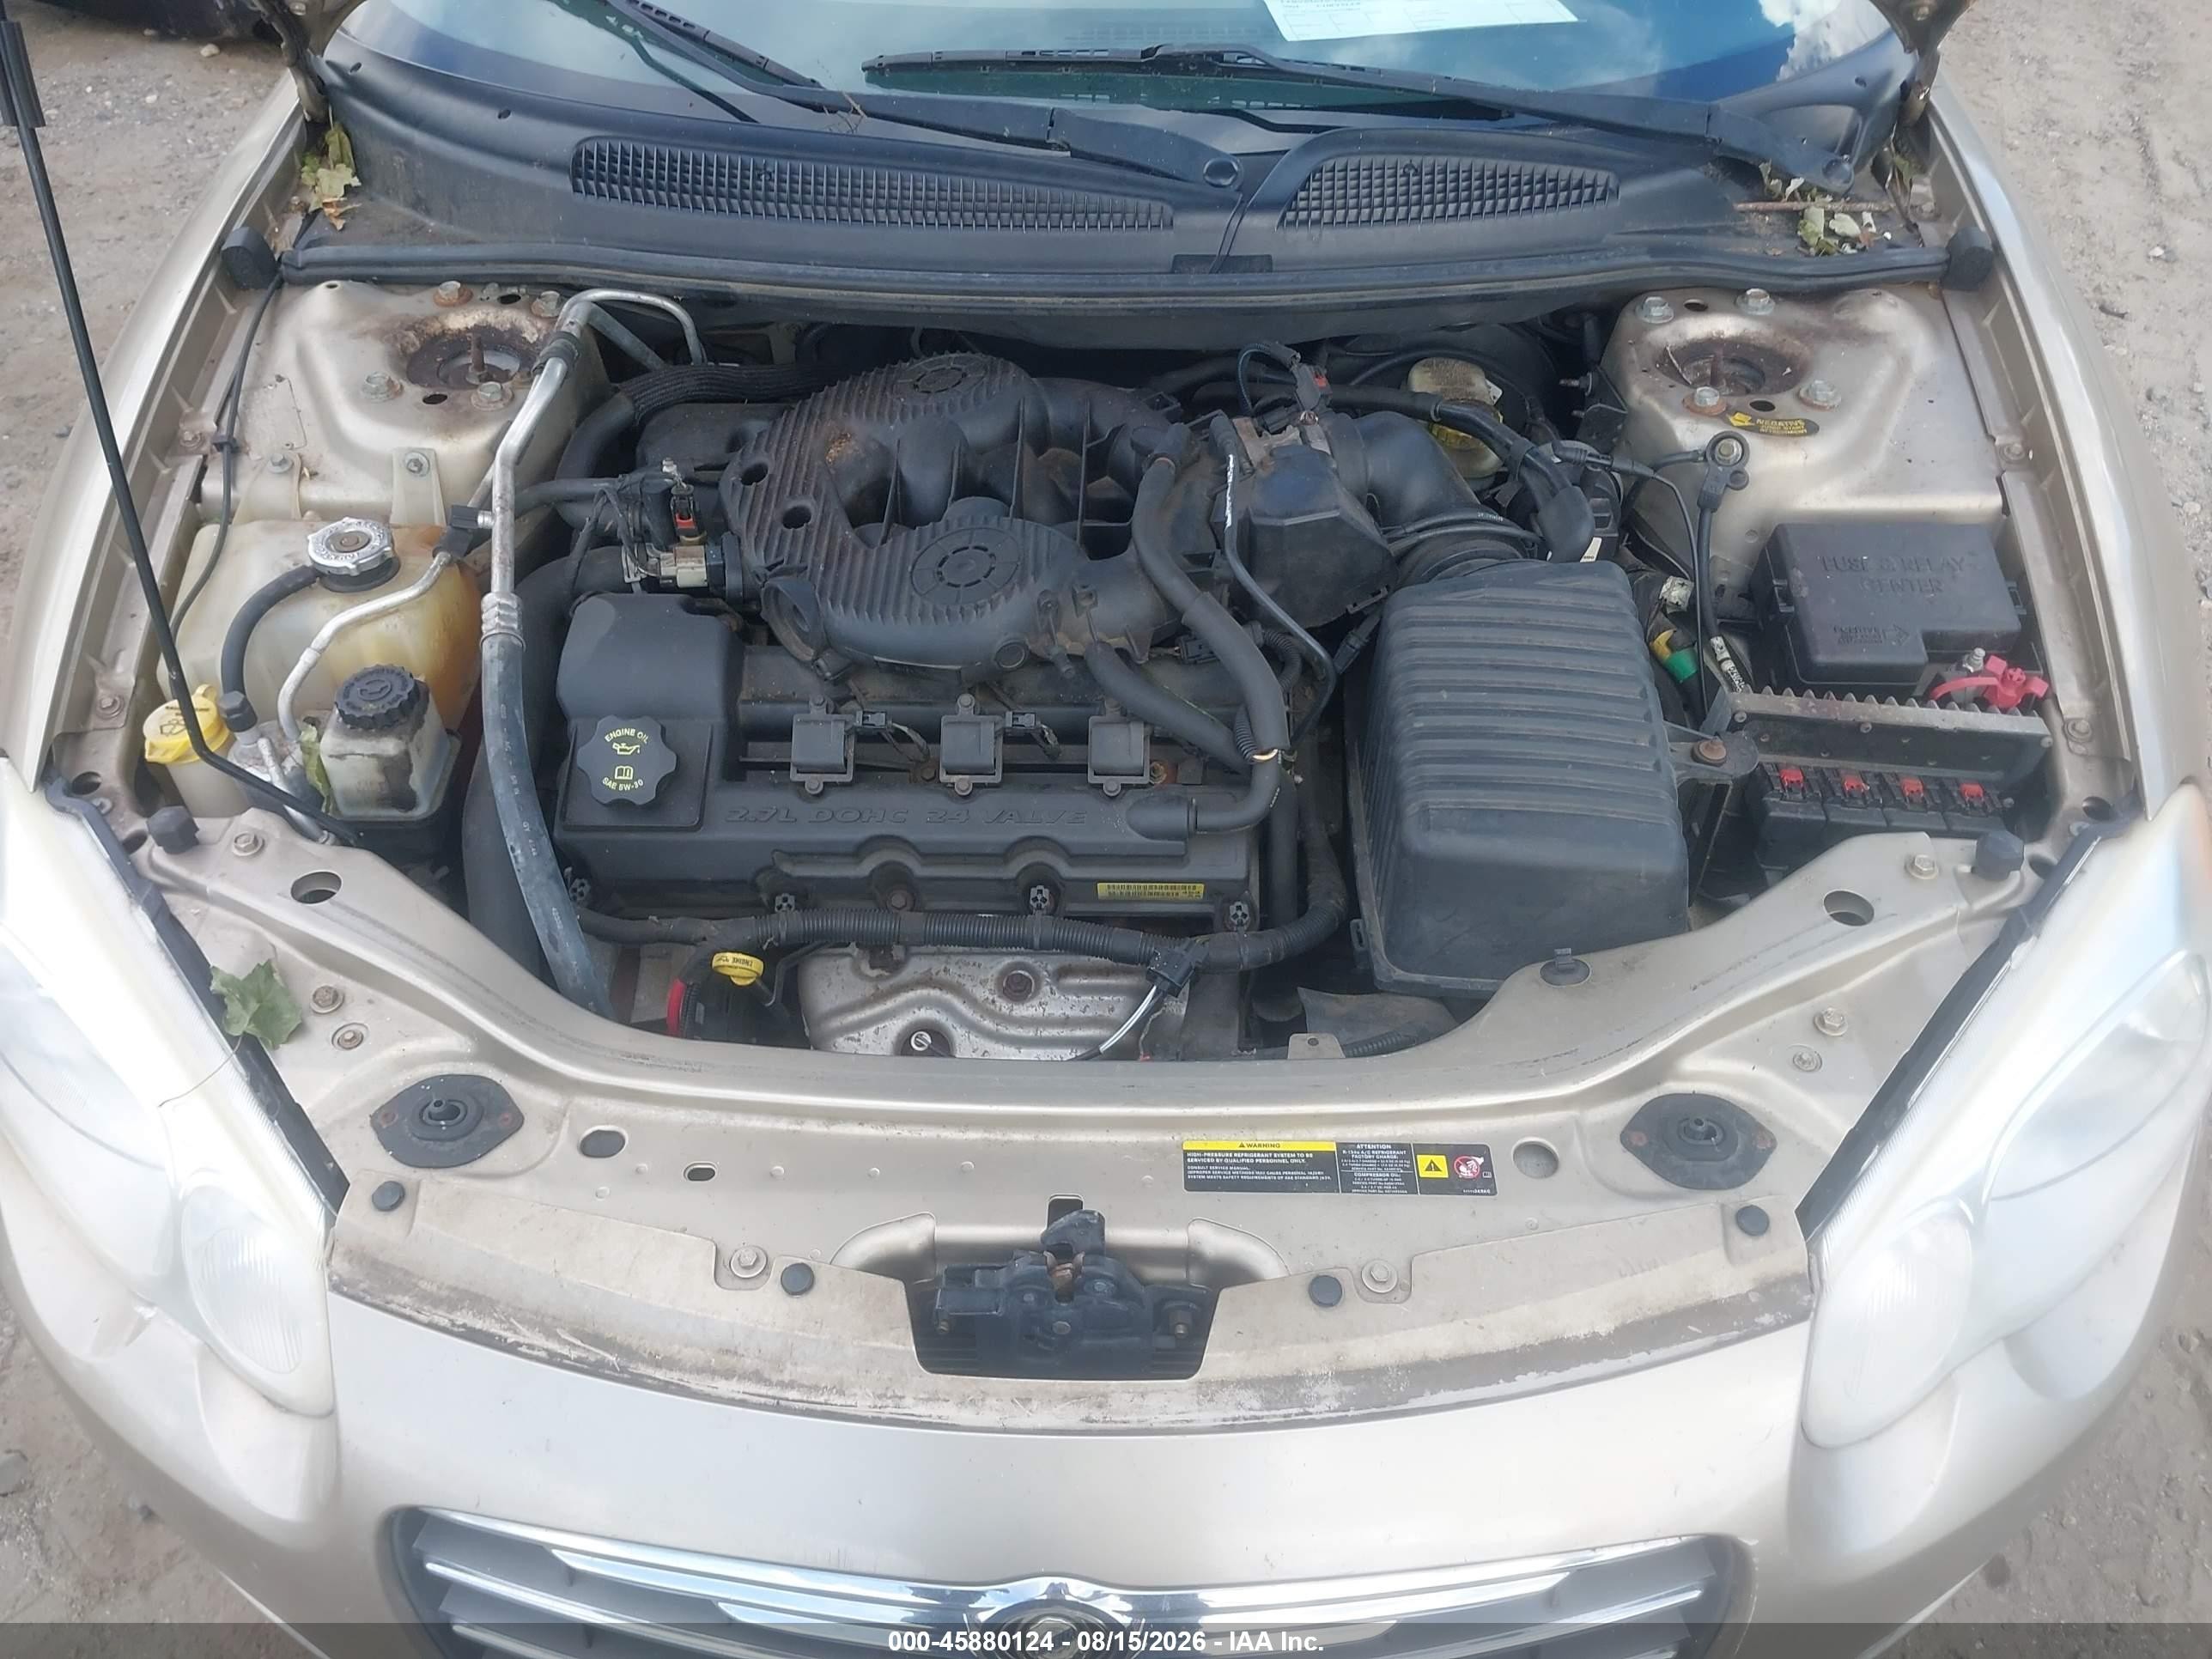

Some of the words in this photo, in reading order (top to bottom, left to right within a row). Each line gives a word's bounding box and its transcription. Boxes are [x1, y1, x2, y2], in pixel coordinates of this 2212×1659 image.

[1820, 556, 1869, 572] FUSE
[1900, 556, 1965, 572] RELAY
[1860, 578, 1944, 593] CENTER
[605, 728, 635, 742] ENGINE
[637, 732, 648, 744] OIL
[602, 776, 617, 790] SAE
[618, 779, 644, 792] 5W-30
[726, 807, 798, 823] 2.7L
[807, 807, 909, 824] DOHC
[925, 809, 969, 824] 24
[982, 810, 1087, 824] VALVE
